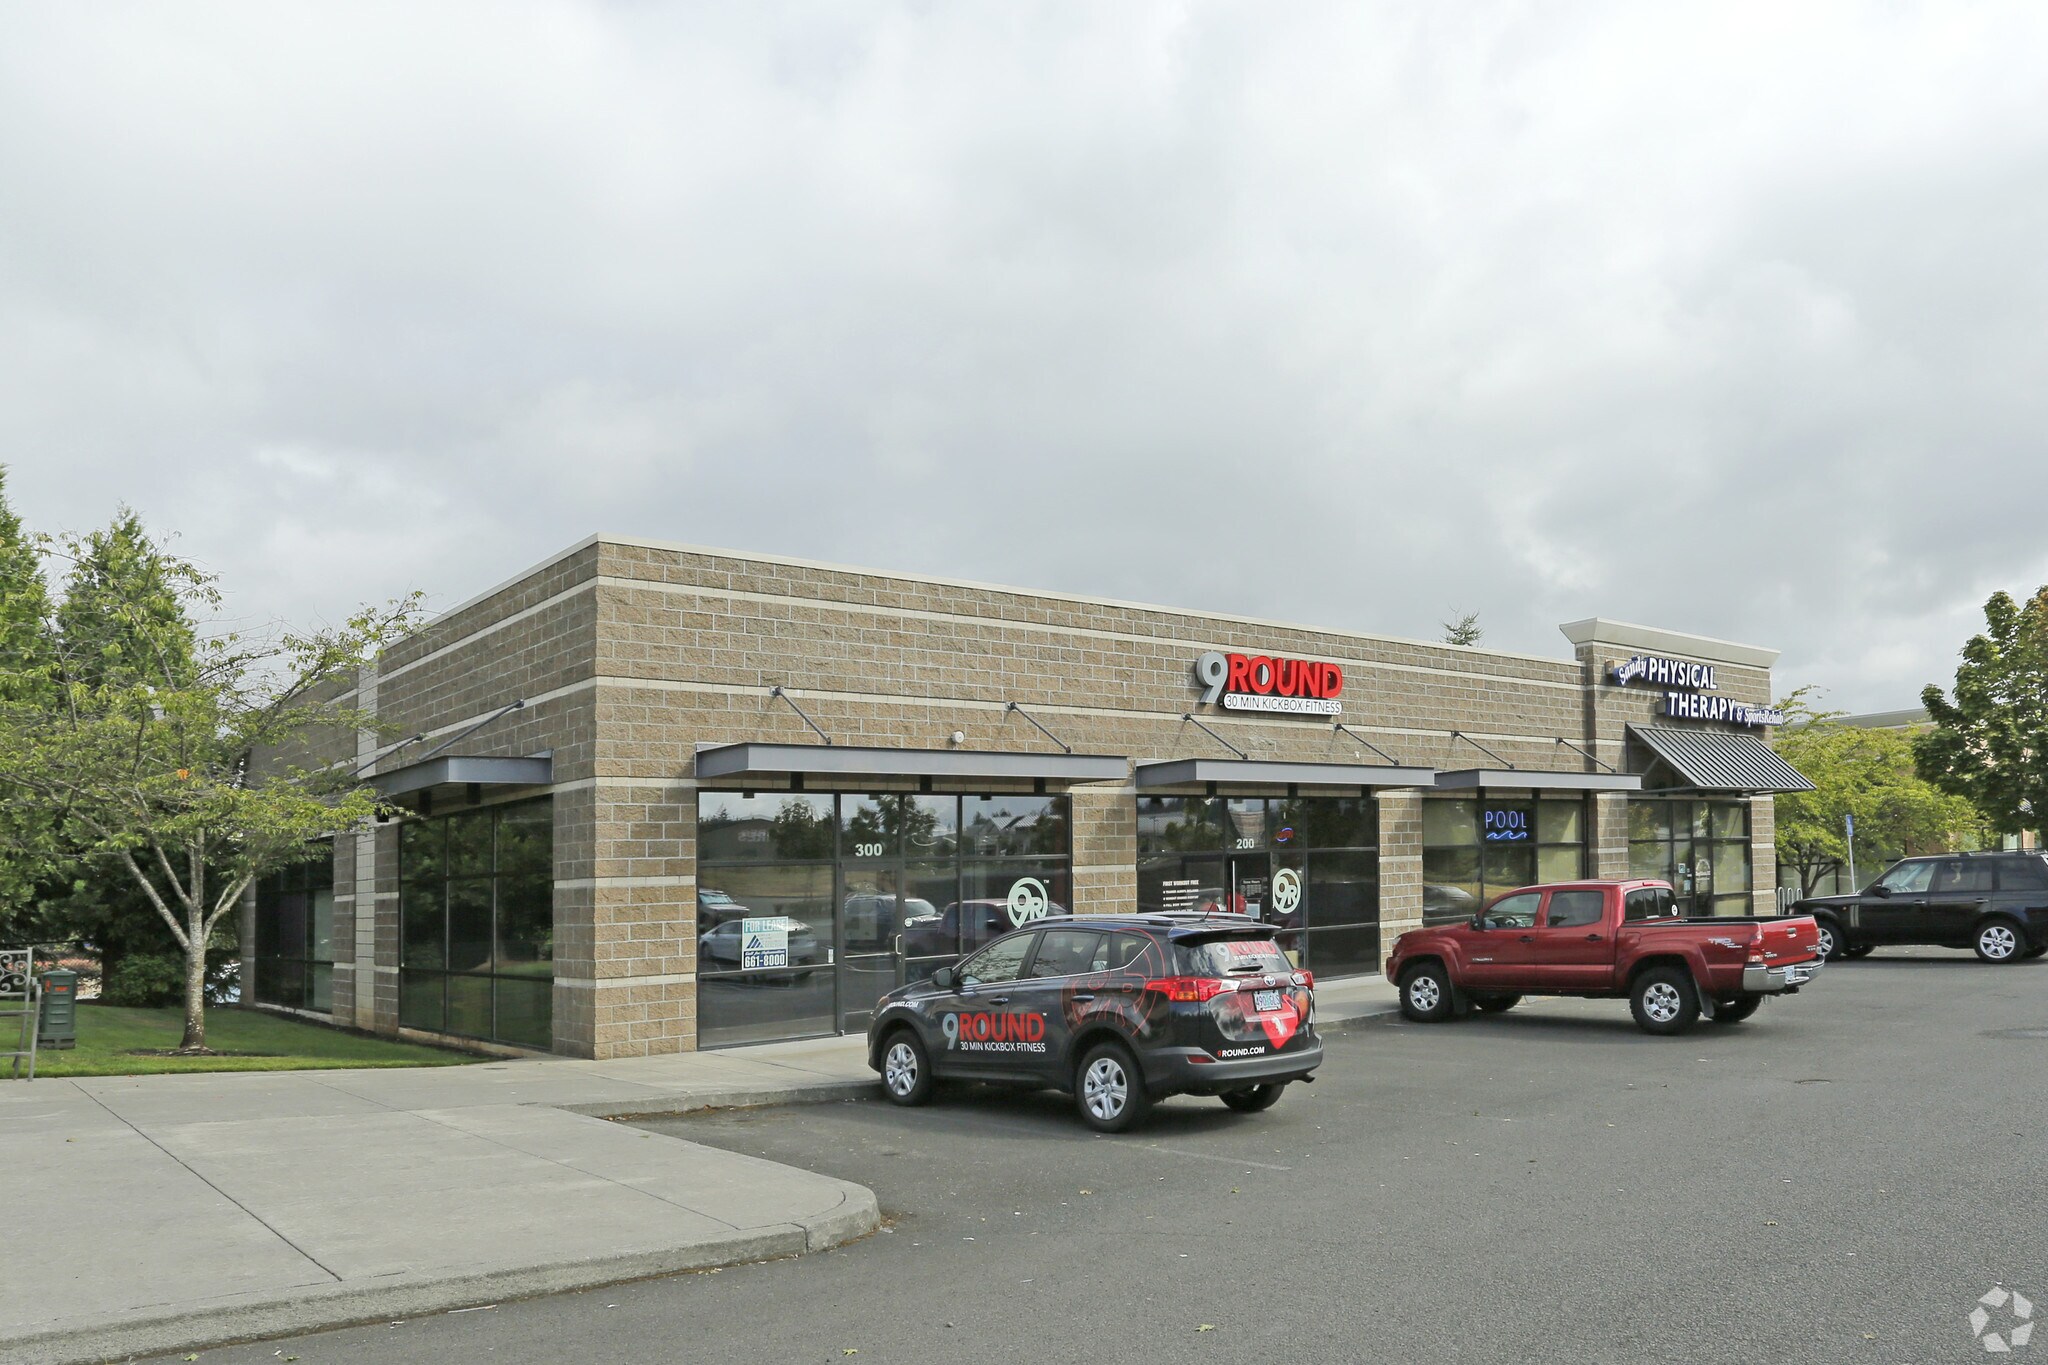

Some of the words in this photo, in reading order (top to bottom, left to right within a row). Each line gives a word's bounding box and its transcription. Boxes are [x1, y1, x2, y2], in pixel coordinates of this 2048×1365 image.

[1196, 652, 1343, 703] 9ROUND
[1619, 656, 1647, 685] Sandy
[1648, 657, 1717, 689] PHYSICAL
[1226, 695, 1238, 708] 30
[1240, 696, 1261, 709] MIN
[1262, 698, 1303, 712] KICKBOX
[1304, 700, 1341, 714] FITNESS
[1668, 692, 1735, 721] THERAPY
[1736, 706, 1743, 722] &
[1485, 811, 1527, 829] POOL
[855, 843, 883, 857] 300
[1236, 838, 1255, 850] 200
[745, 920, 760, 931] FOR
[762, 919, 786, 931] LEASE
[744, 954, 785, 968] 661-8000
[942, 1012, 1045, 1050] 9ROUND
[960, 1041, 969, 1051] 30
[969, 1042, 984, 1052] MIN
[984, 1042, 1016, 1052] KICKBOX
[1016, 1042, 1046, 1053] FITNESS
[1217, 1046, 1265, 1057] 9ROUND.COM
